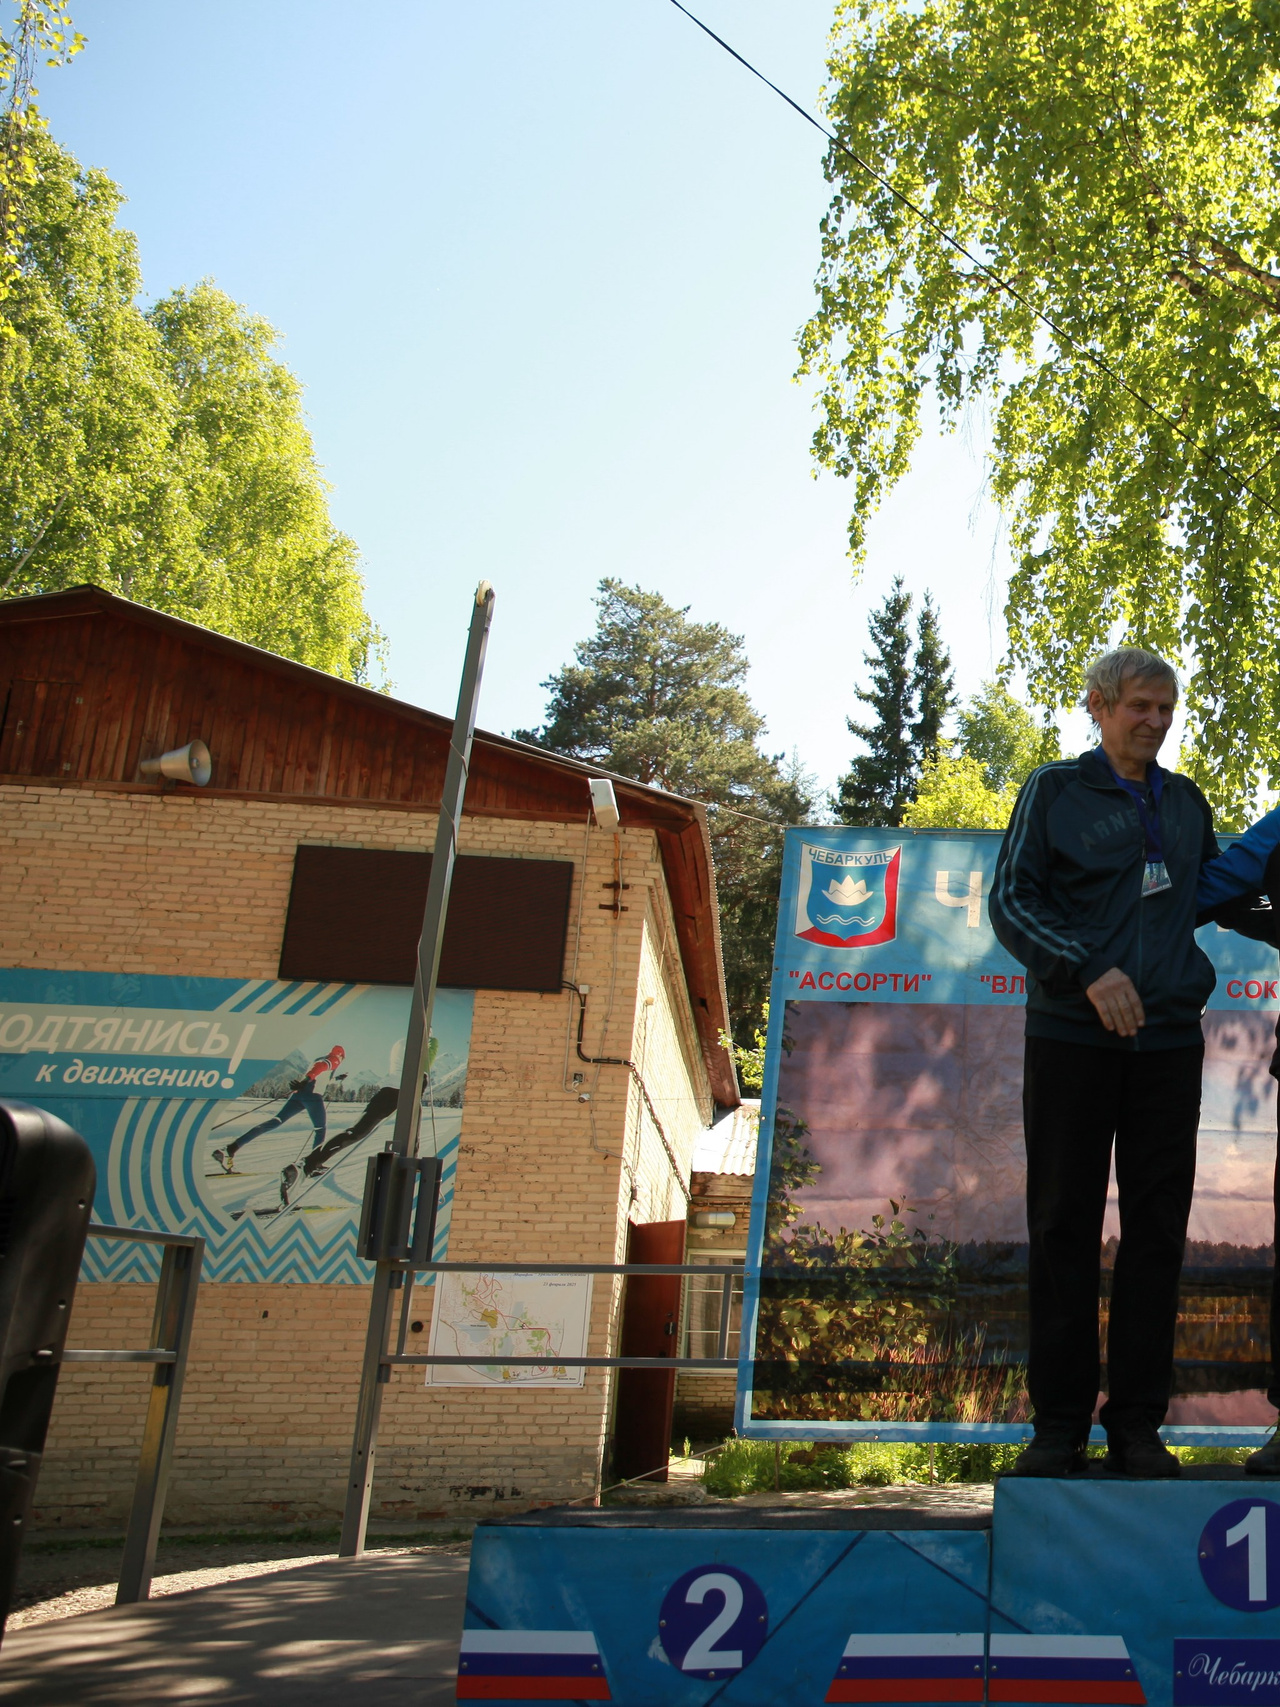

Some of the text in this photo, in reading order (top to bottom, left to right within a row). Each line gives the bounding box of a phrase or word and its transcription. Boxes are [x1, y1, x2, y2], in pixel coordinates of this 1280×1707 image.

[808, 847, 893, 866] ЧЕБАРКУЛЬ
[935, 870, 996, 929] Ч
[789, 971, 932, 993] "АССОРТИ"
[980, 975, 1028, 994] "ВЛ
[1226, 1506, 1267, 1601] 1
[682, 1572, 744, 1670] 2
